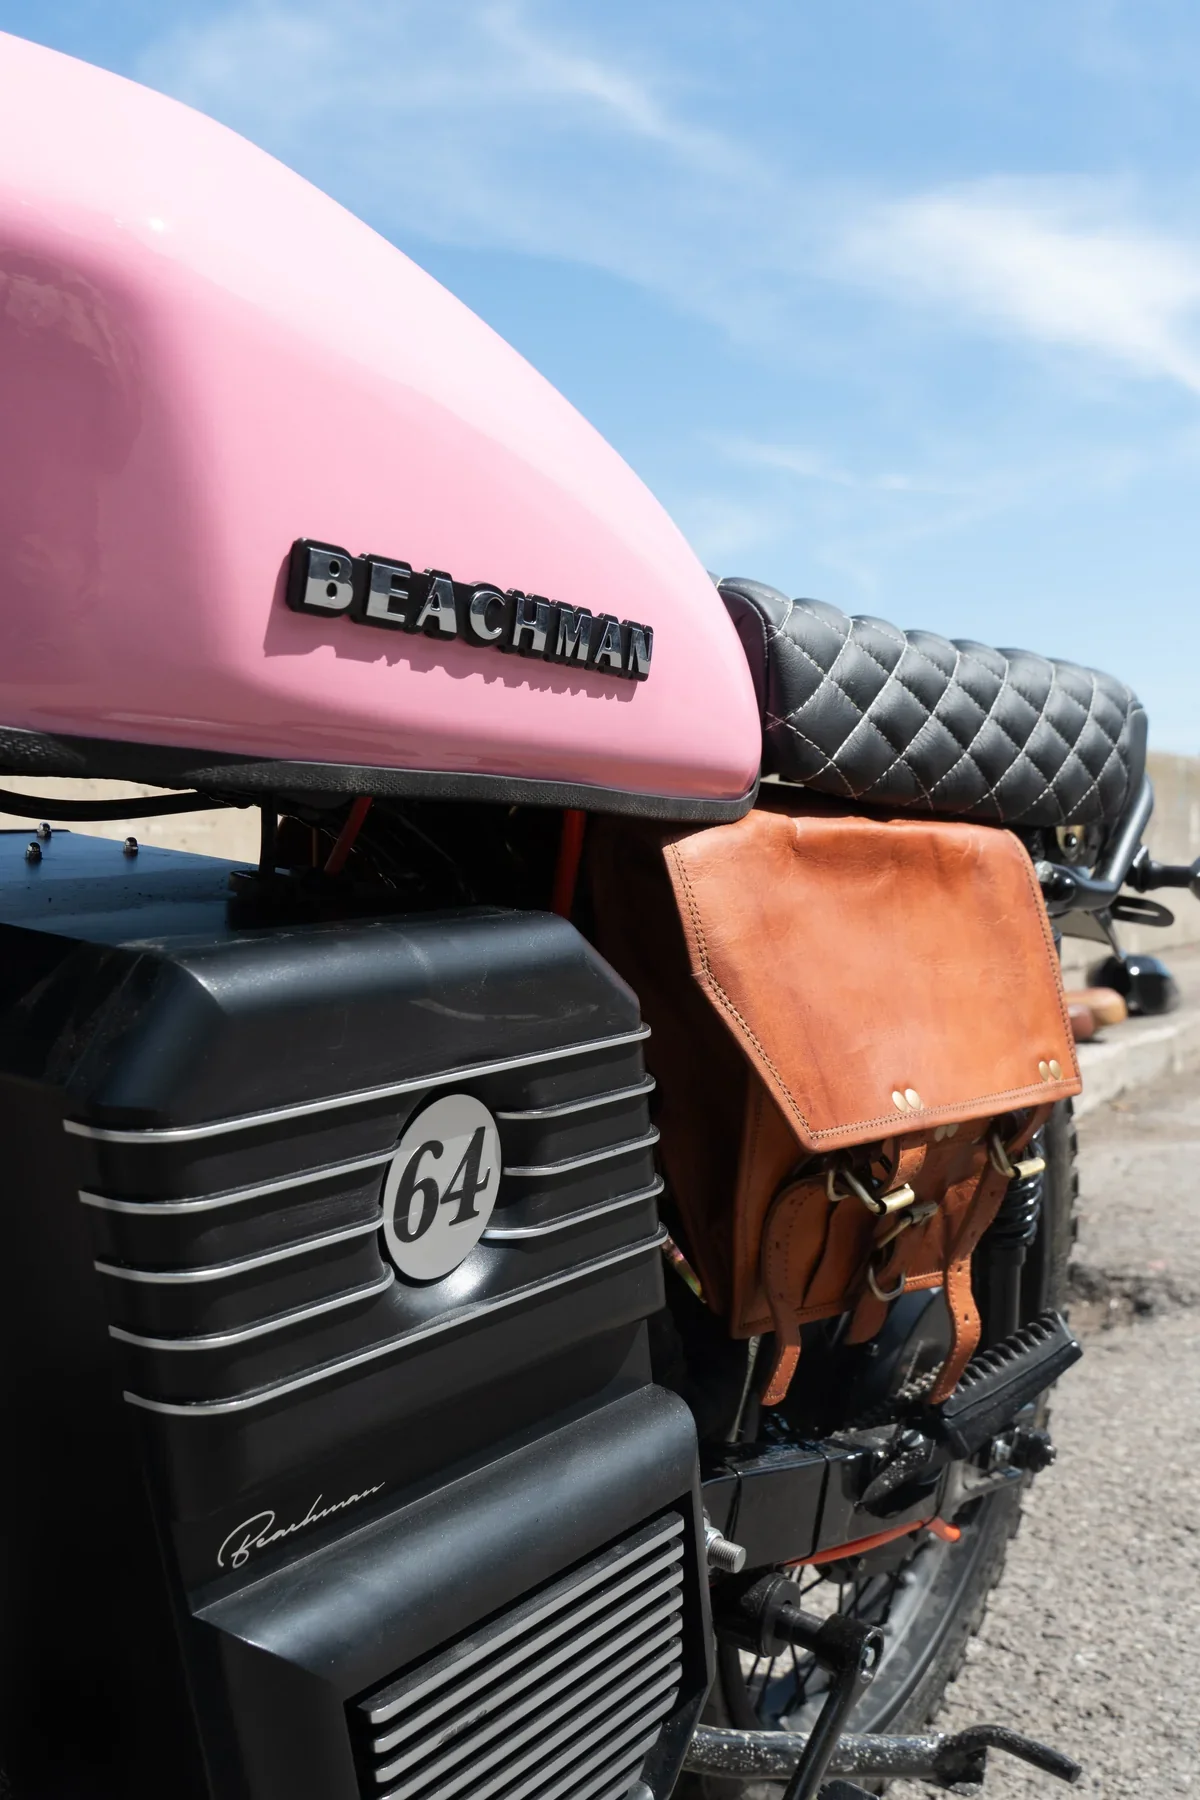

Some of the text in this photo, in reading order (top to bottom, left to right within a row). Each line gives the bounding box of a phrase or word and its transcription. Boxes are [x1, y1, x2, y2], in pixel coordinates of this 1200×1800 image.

[303, 546, 653, 677] BEACHMAN
[393, 1126, 491, 1243] 64
[217, 1481, 386, 1569] Beachman
